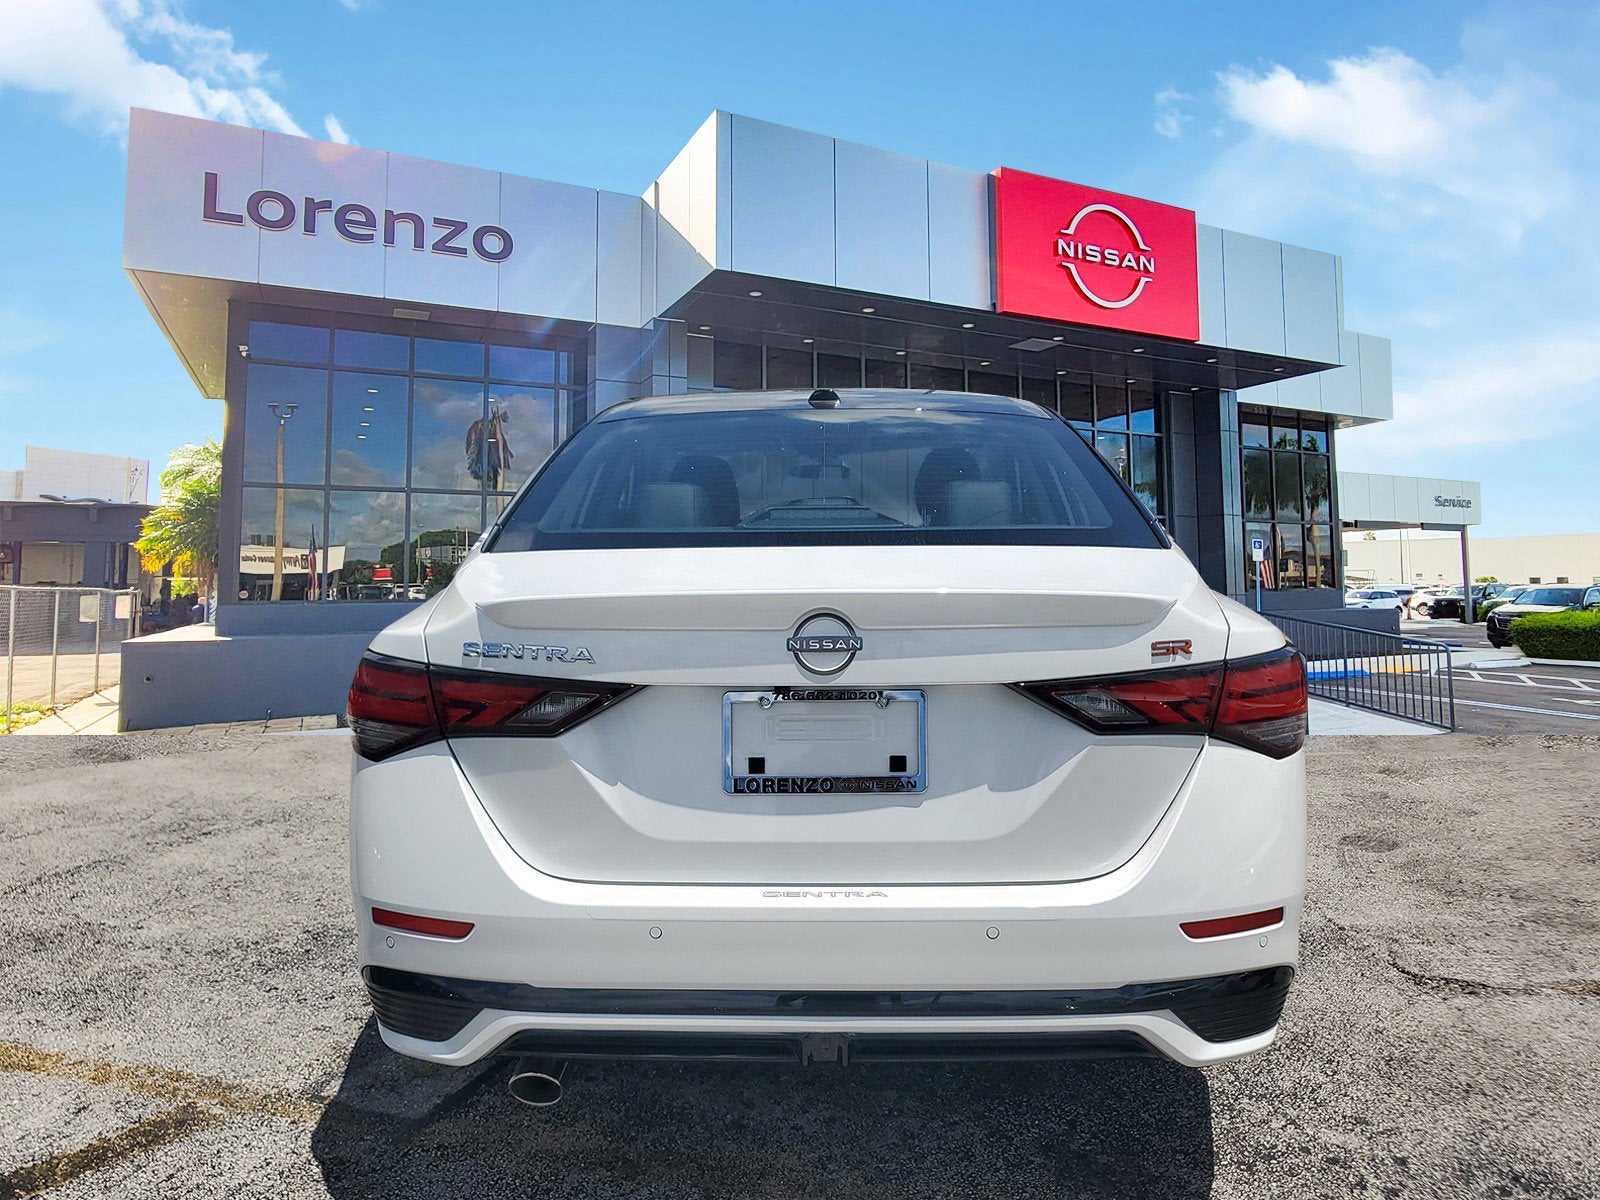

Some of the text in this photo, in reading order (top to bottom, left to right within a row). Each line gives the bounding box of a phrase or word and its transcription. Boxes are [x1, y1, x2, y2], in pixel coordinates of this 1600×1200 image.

[202, 170, 514, 262] Lorenzo
[1057, 238, 1155, 273] NISSAN
[1434, 495, 1472, 509] Service
[462, 641, 596, 664] SENTRA
[788, 639, 861, 650] NISSAN
[1151, 639, 1193, 657] SR
[733, 777, 917, 794] LORENZO NISSAN
[762, 890, 888, 898] SENTRA
